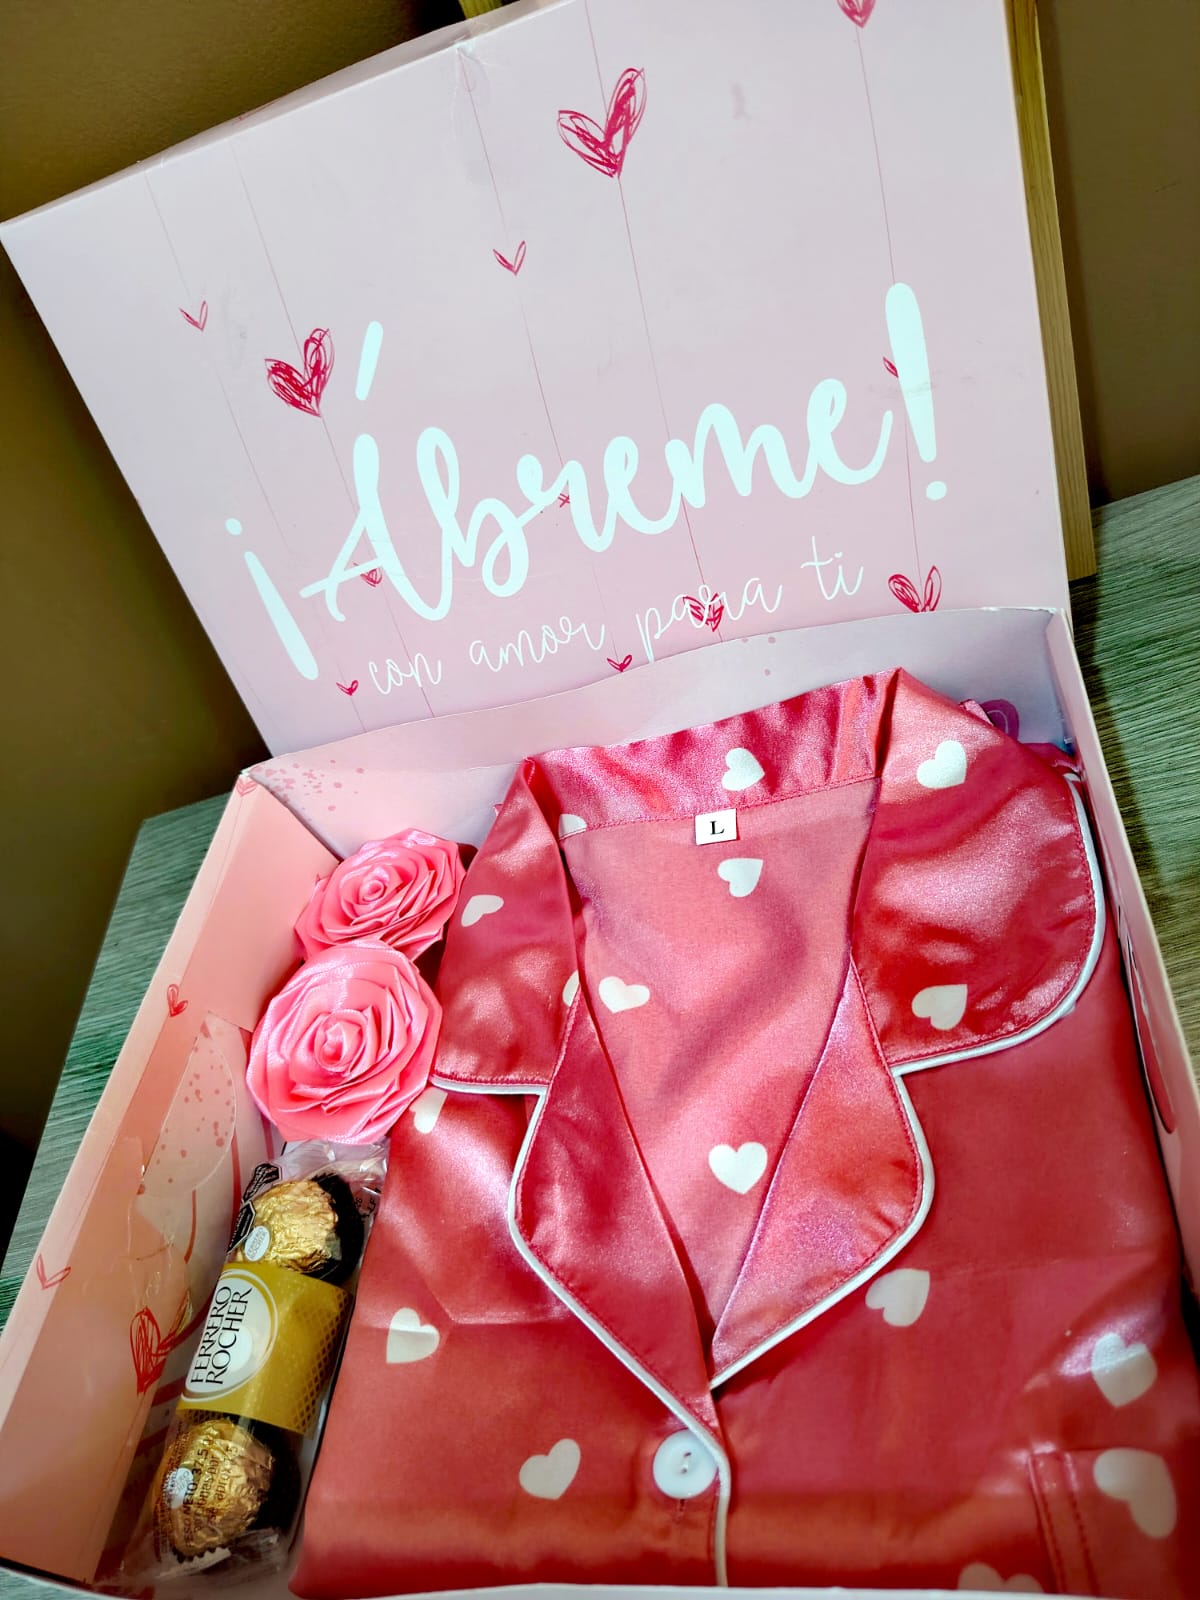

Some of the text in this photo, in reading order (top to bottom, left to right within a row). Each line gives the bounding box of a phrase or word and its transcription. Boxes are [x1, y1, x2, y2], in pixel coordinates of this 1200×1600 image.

[224, 283, 948, 681] ¡Ábreme!
[368, 536, 864, 695] con amor para ti
[709, 820, 725, 836] L
[190, 1286, 232, 1383] FERRERO
[205, 1287, 253, 1385] ROCHER
